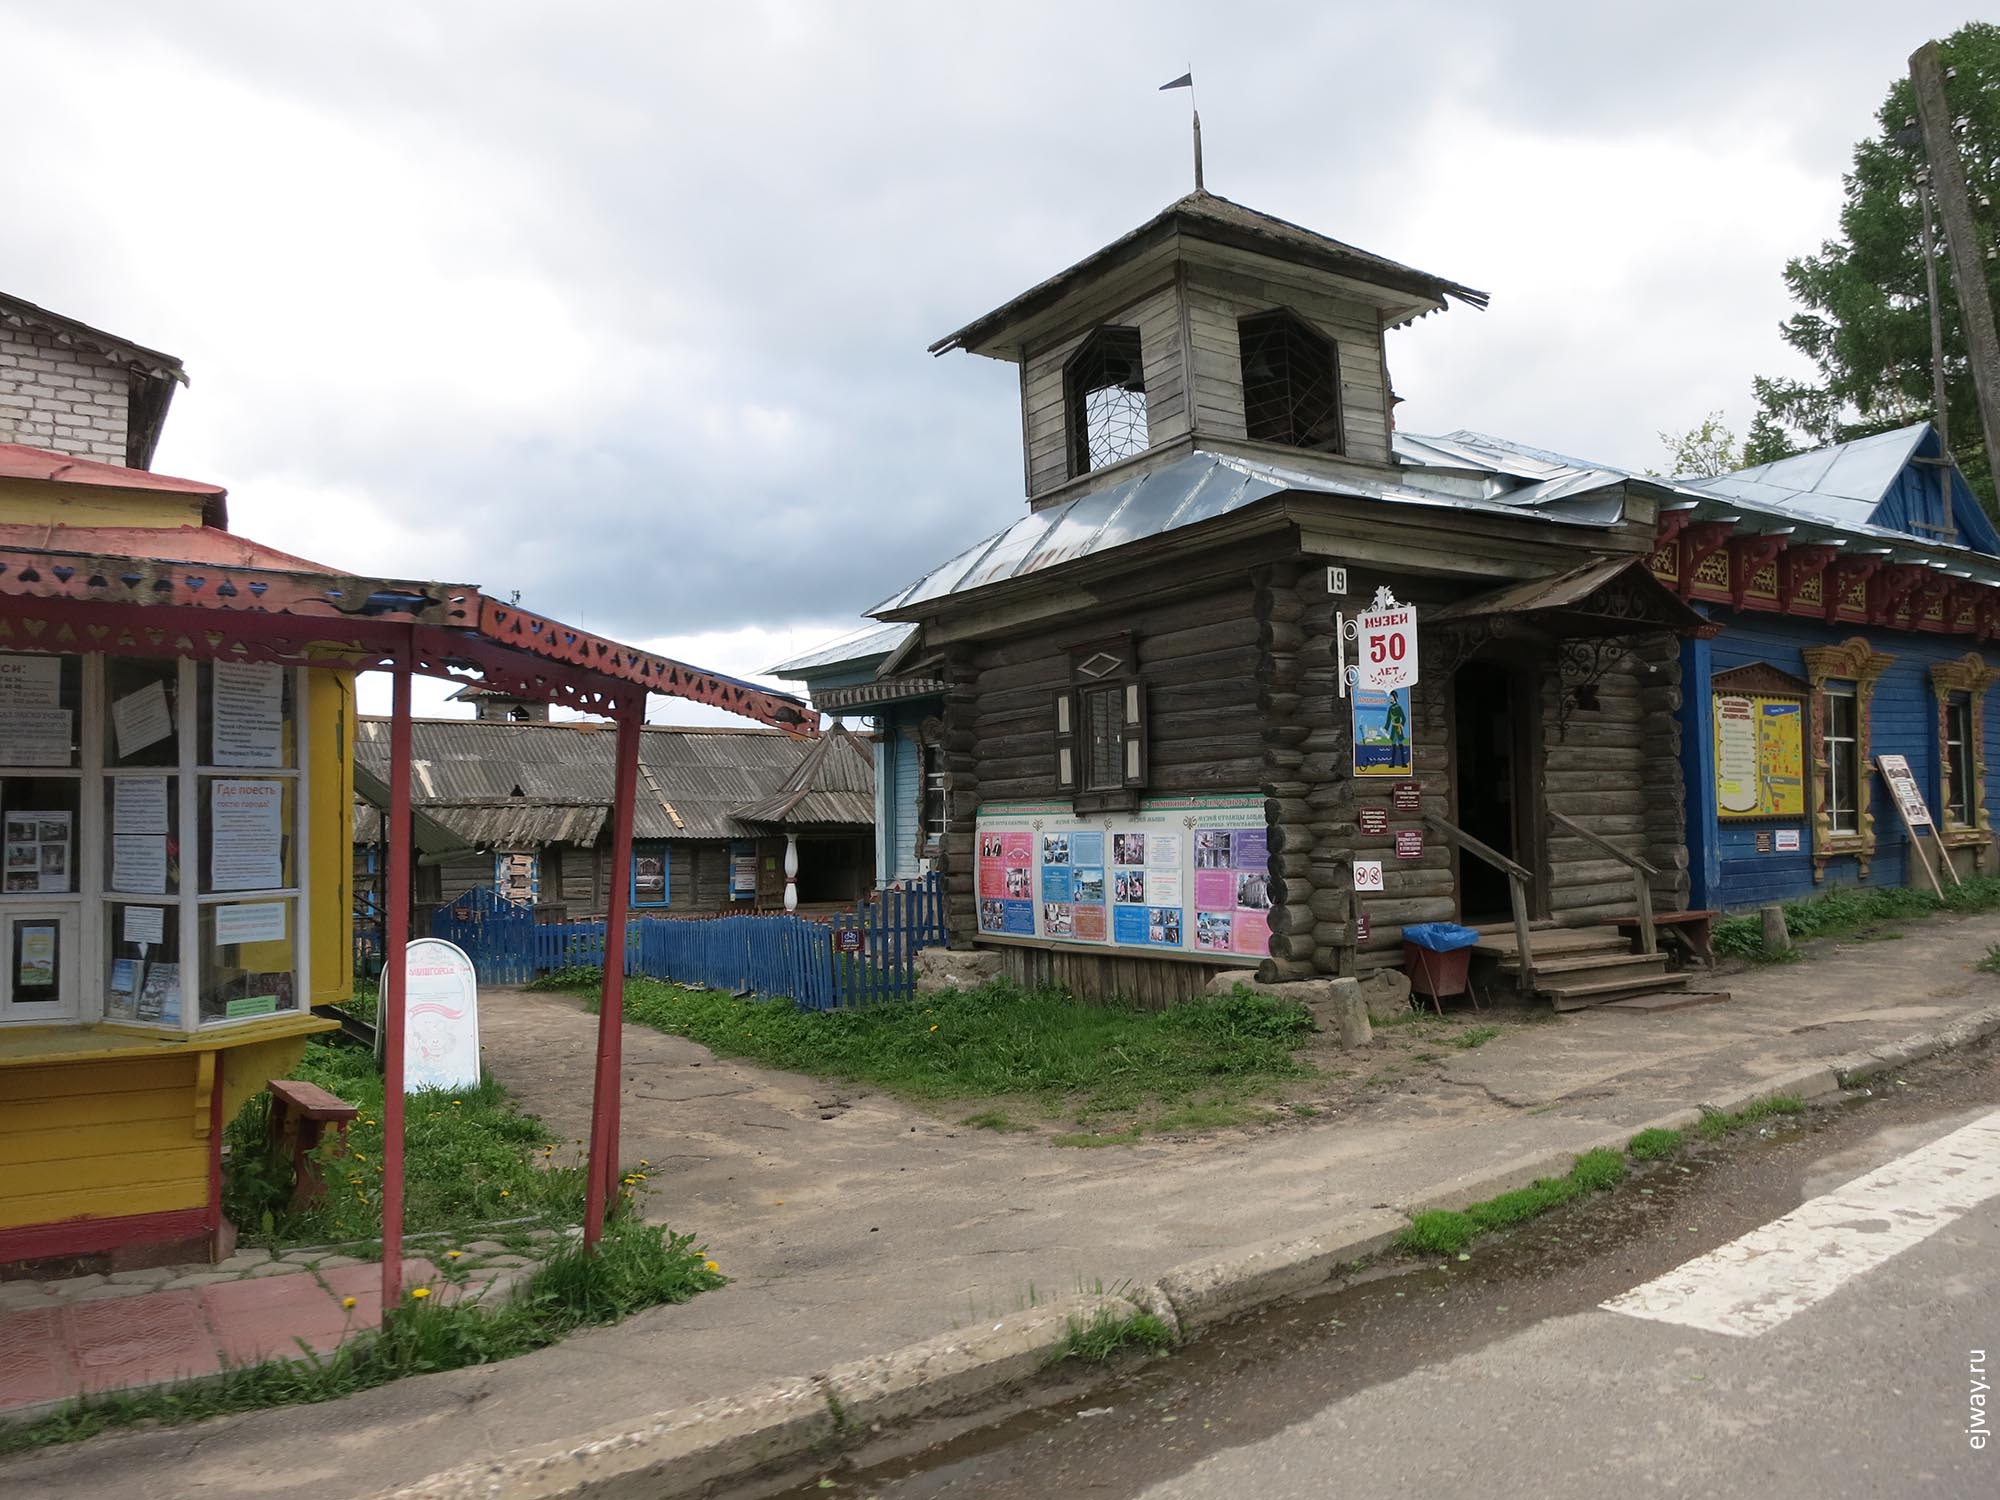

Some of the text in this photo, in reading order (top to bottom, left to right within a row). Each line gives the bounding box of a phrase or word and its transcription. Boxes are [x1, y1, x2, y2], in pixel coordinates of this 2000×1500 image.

[1330, 570, 1345, 591] 19
[1370, 633, 1406, 663] 50
[1377, 666, 1399, 677] ЛЕТ
[217, 783, 276, 797] Где поесть
